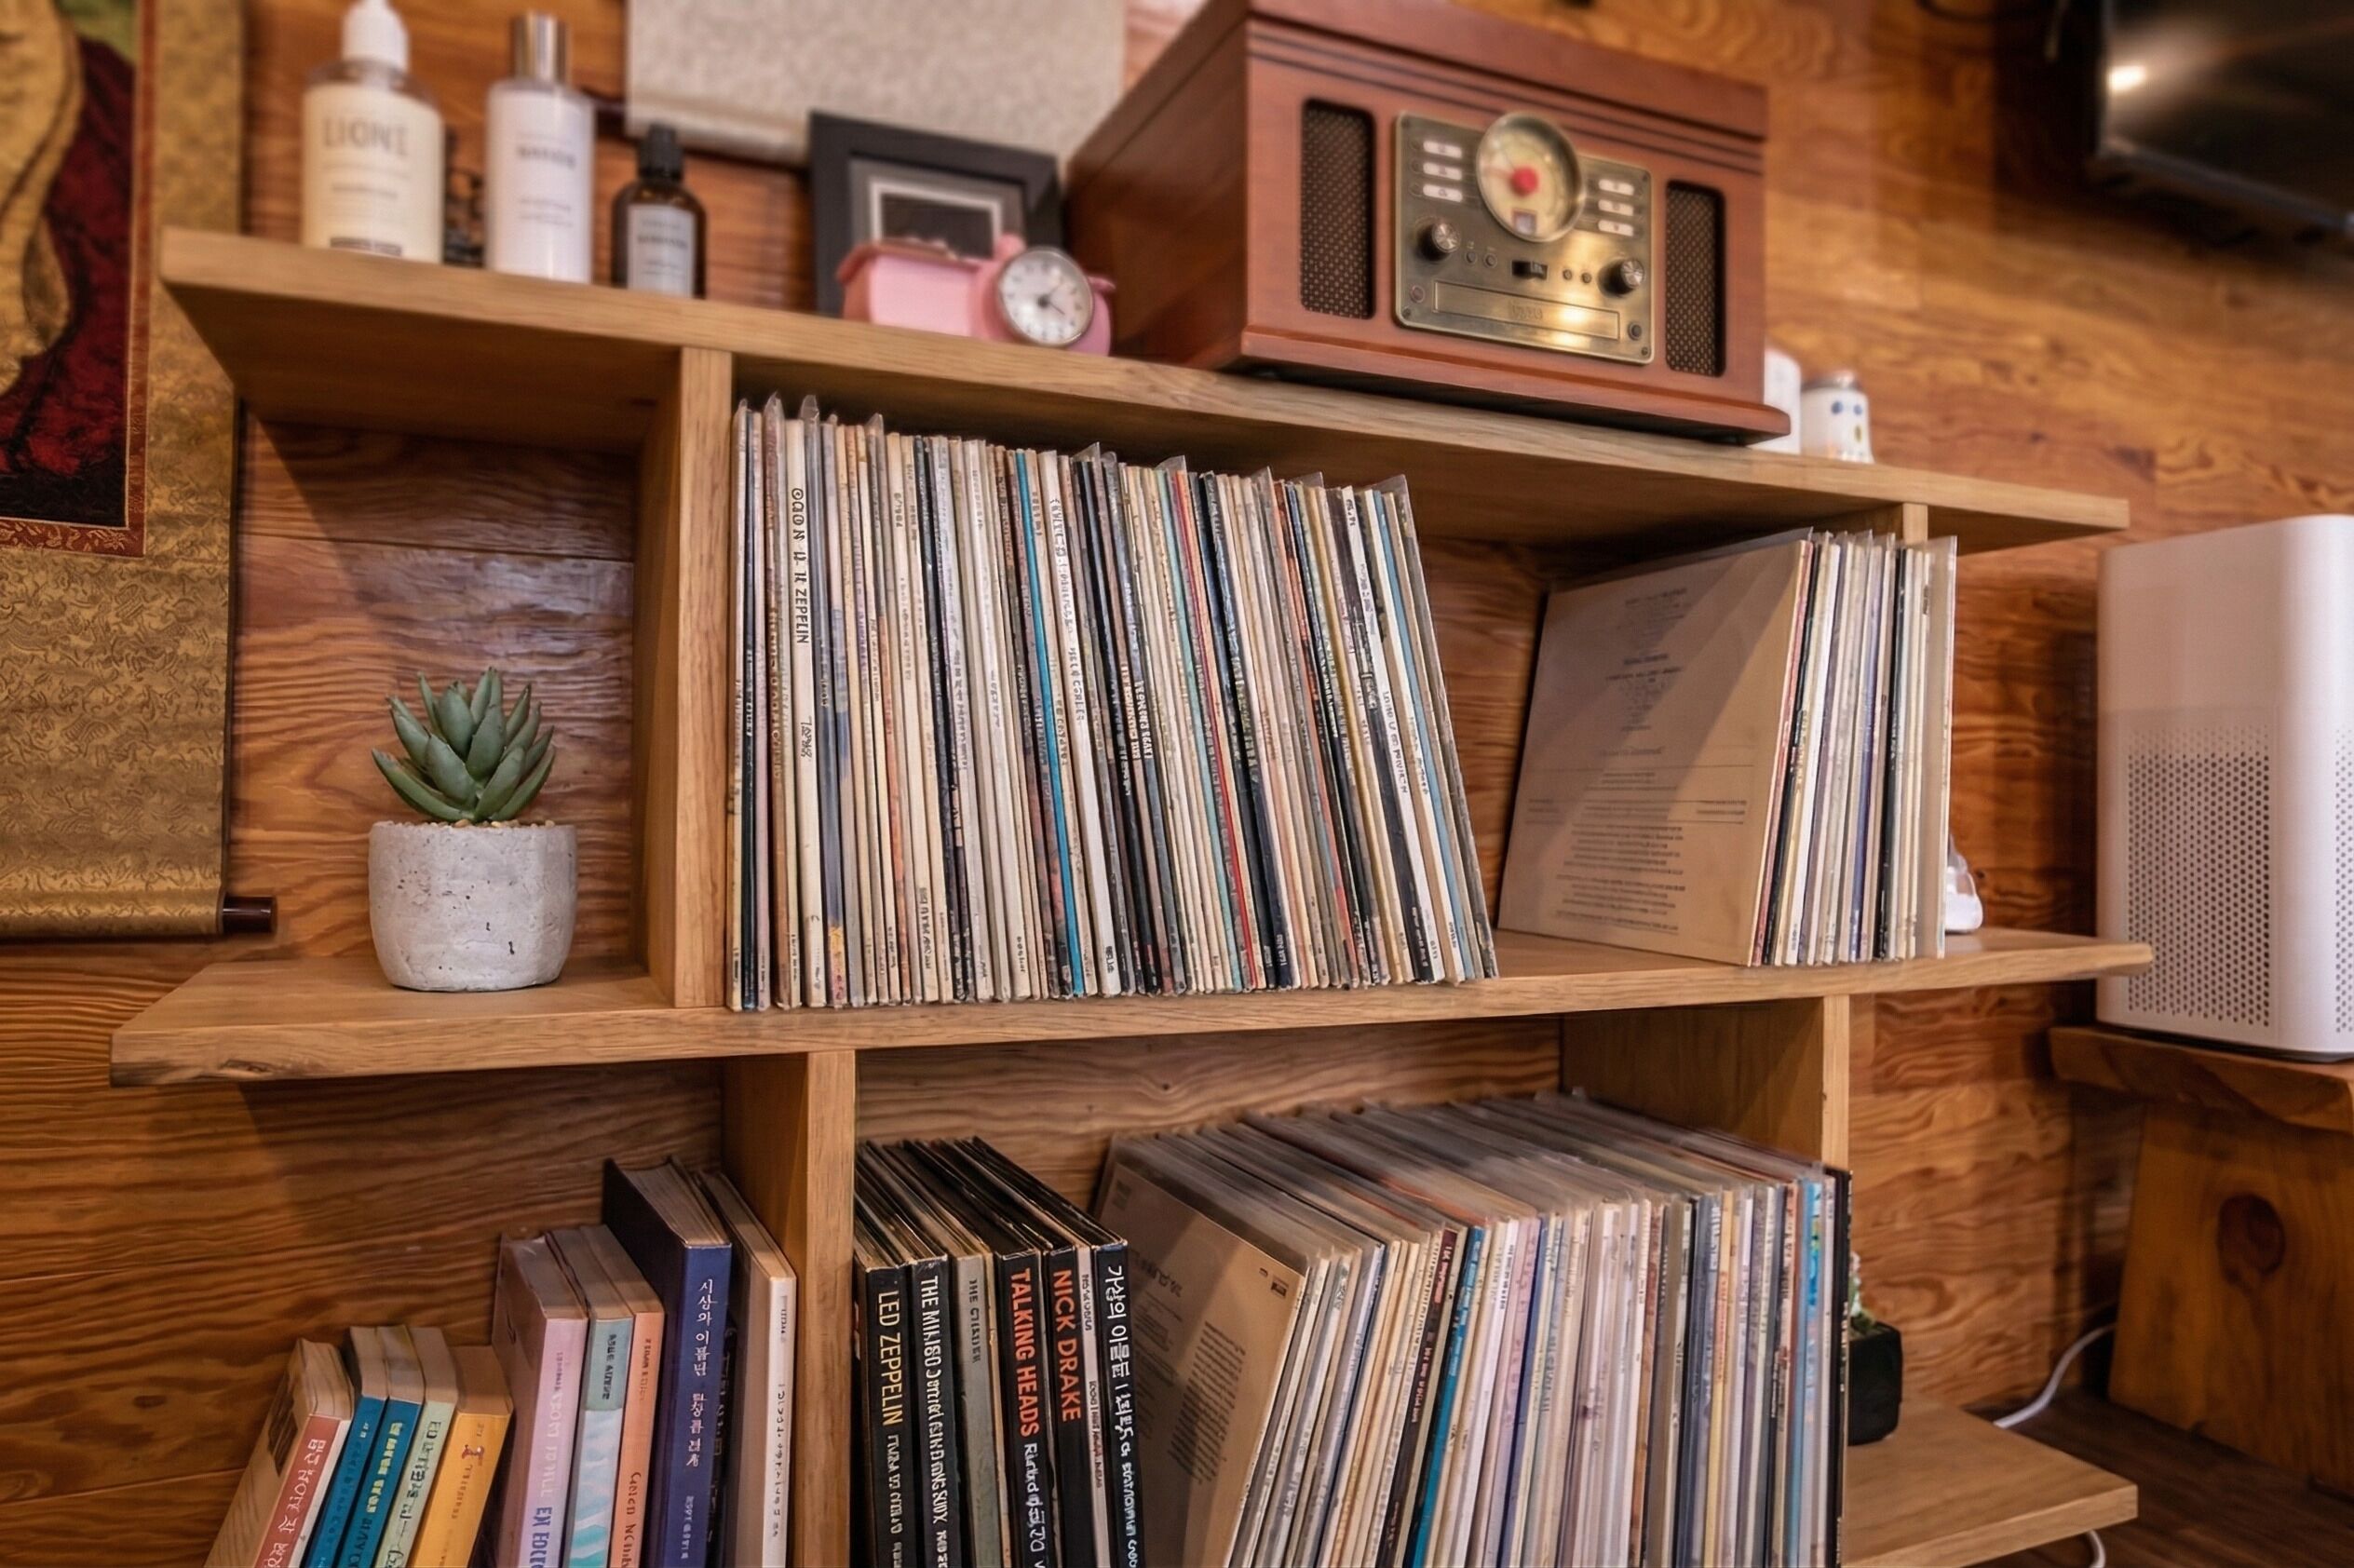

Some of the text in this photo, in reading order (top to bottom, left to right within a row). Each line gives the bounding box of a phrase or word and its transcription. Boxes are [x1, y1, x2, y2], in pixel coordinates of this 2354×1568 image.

[878, 1291, 900, 1327] LED
[920, 1276, 940, 1308] THE
[1010, 1267, 1035, 1360] TALKING
[879, 1332, 903, 1426] ZEPPELIN
[1053, 1269, 1081, 1422] NICK DRAKE
[1016, 1364, 1040, 1438] HEADS
